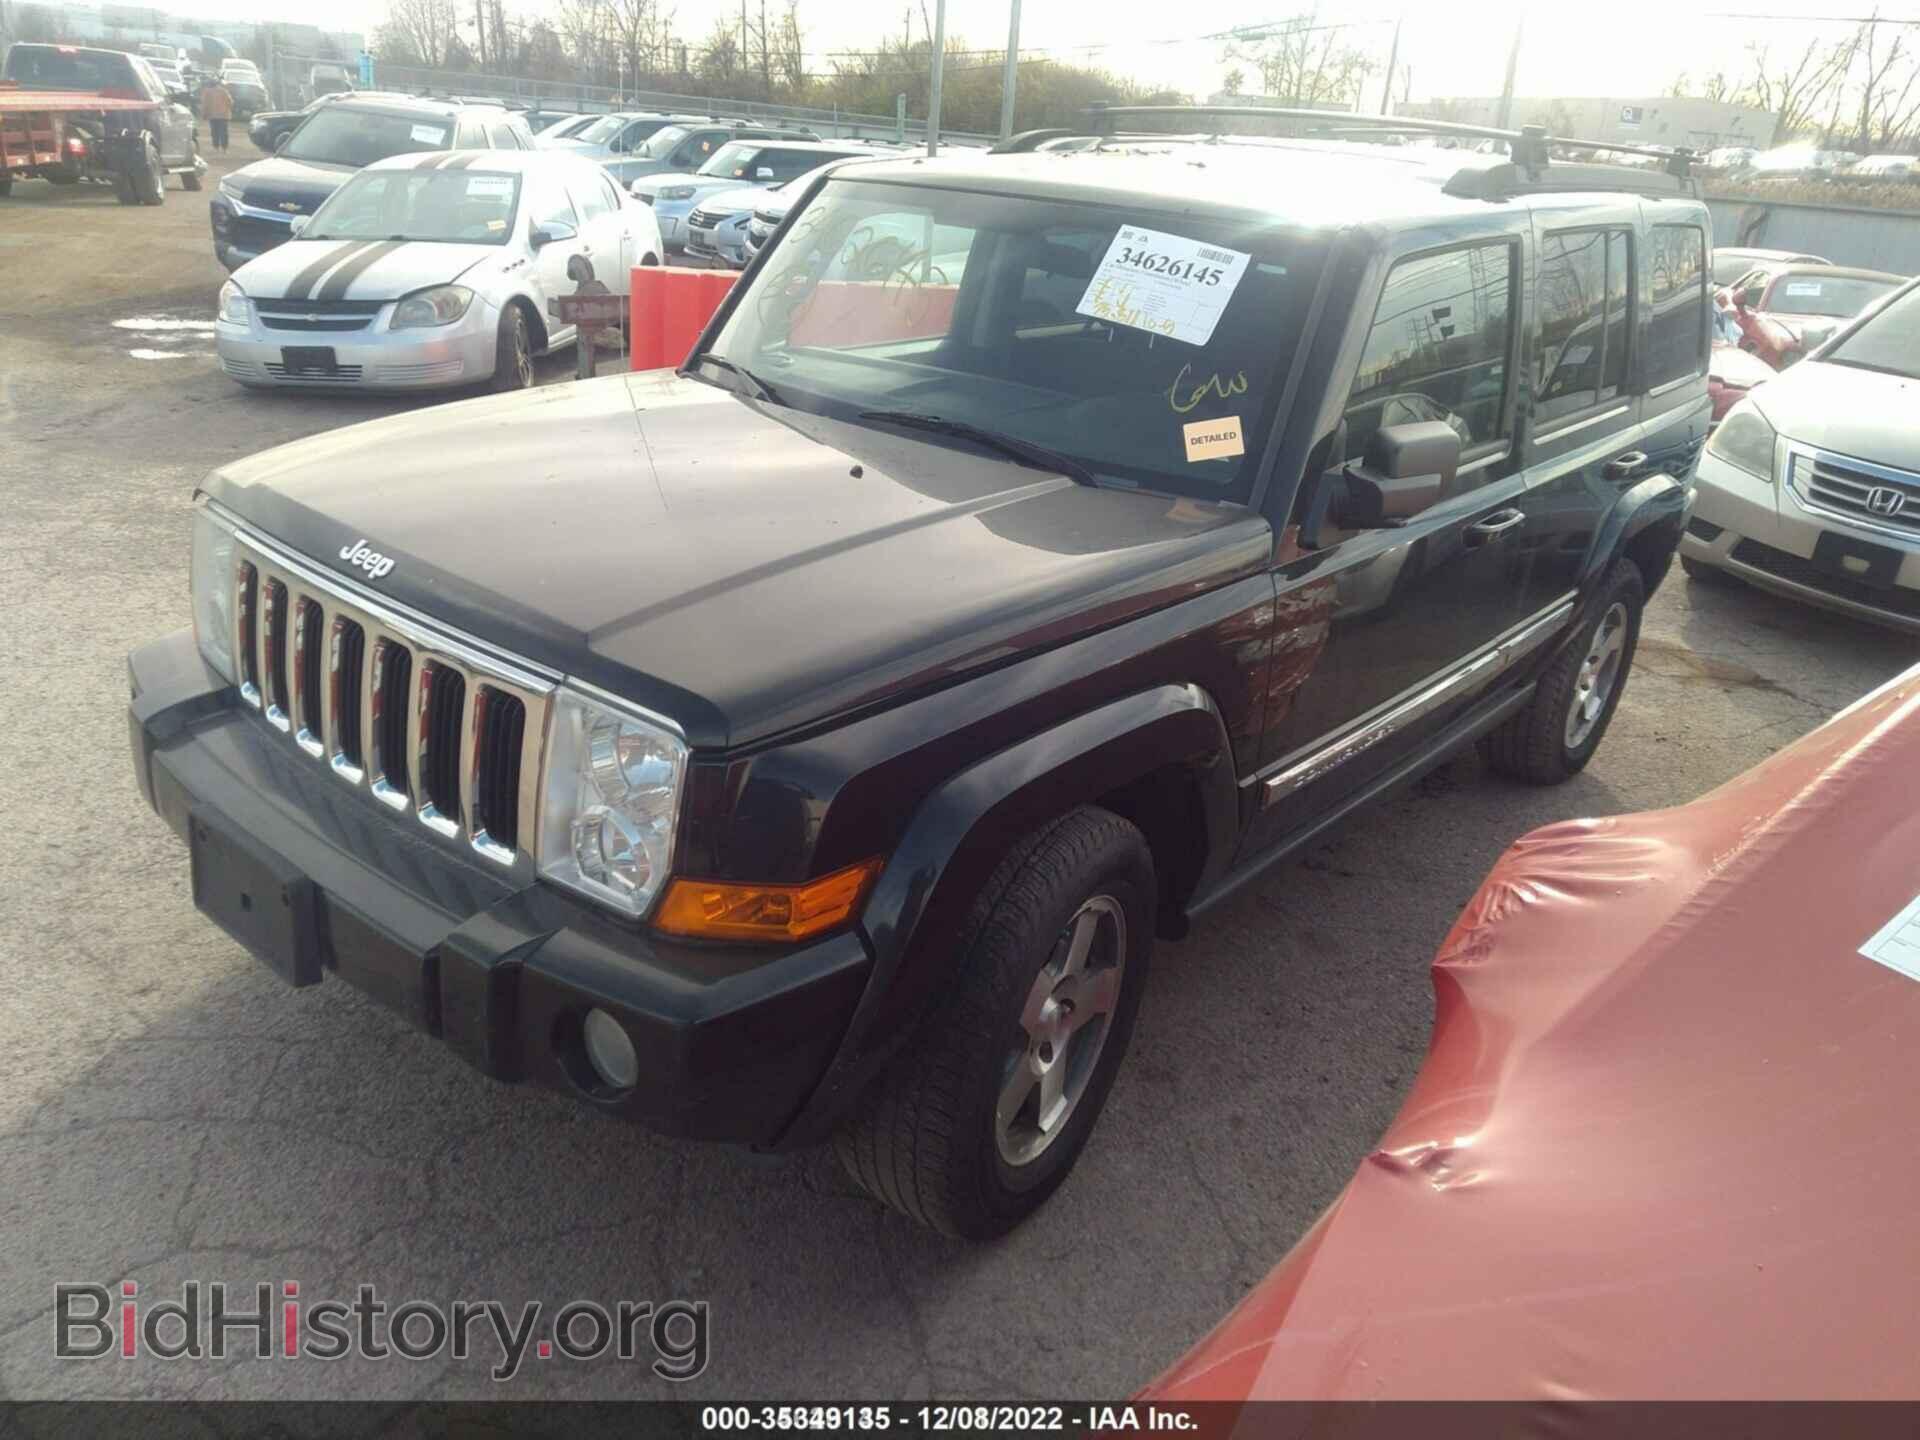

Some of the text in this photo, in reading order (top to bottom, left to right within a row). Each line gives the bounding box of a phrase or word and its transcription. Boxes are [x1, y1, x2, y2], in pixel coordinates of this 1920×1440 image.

[1116, 247, 1225, 287] 34626145
[1190, 431, 1237, 446] DETAILED
[339, 539, 395, 579] Jeep
